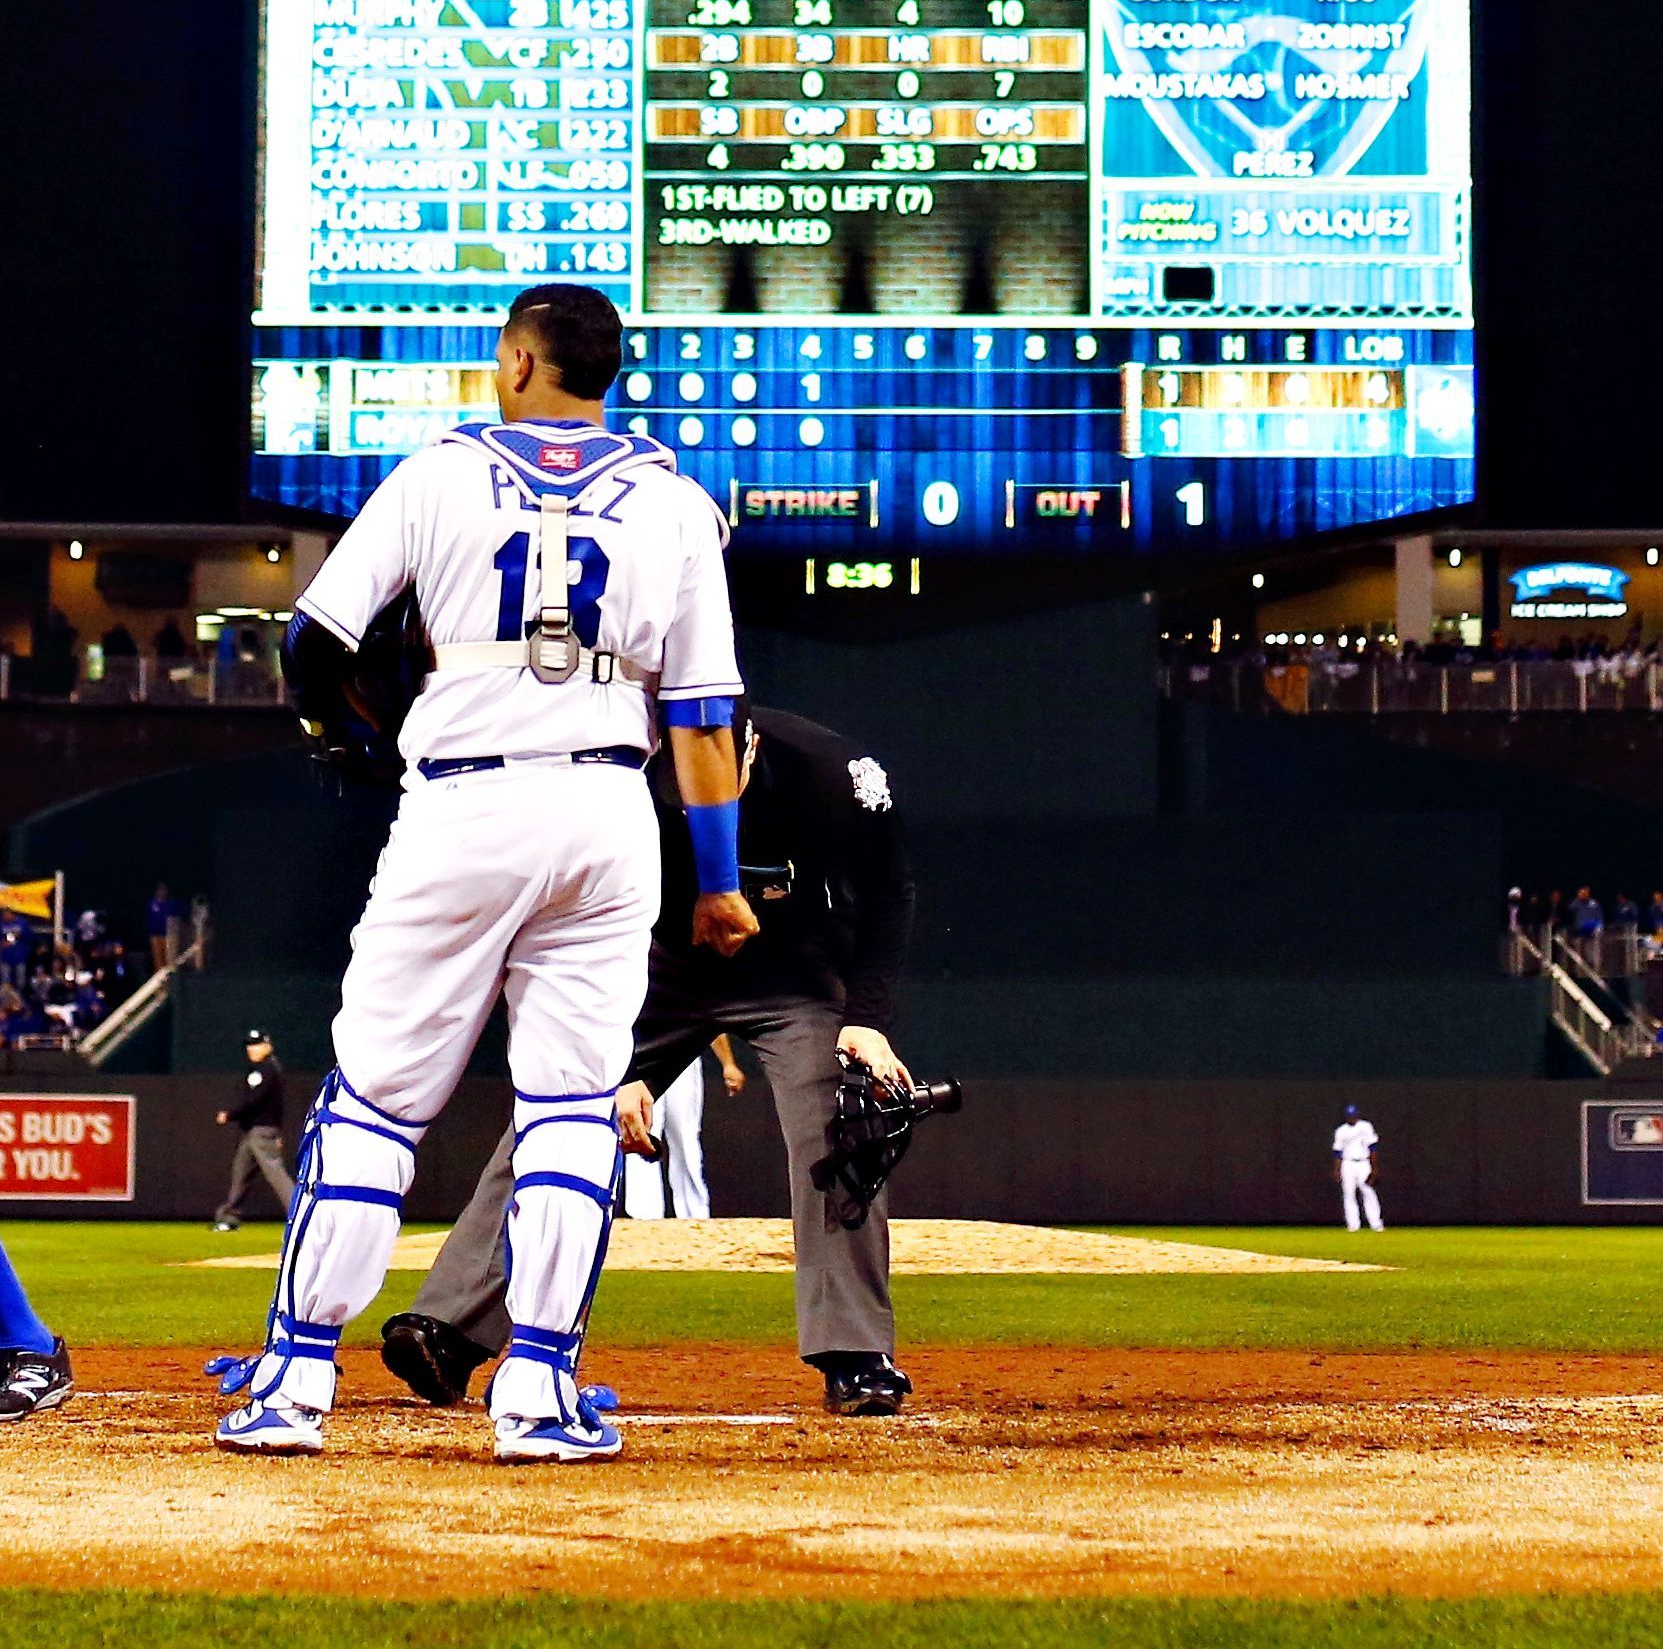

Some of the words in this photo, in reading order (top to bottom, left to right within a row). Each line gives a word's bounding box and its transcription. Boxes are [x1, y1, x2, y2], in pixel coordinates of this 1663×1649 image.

[896, 0, 920, 26] 4
[887, 35, 930, 63] HR
[1123, 23, 1246, 50] ESCOBAR
[1297, 23, 1406, 50] ZOBRIST
[508, 38, 548, 67] CF
[707, 69, 729, 98] 2
[800, 69, 824, 98] 0
[896, 69, 919, 98] 0
[993, 70, 1016, 98] 7
[1103, 73, 1266, 100] MOUSTAKAS
[1294, 73, 1411, 100] HOSMER
[699, 106, 739, 135] SB
[876, 106, 934, 135] SLG
[975, 106, 1034, 135] OPS
[706, 143, 730, 170] 4
[780, 143, 845, 171] .390
[871, 143, 935, 171] .353
[972, 143, 1037, 171] .743
[1232, 150, 1315, 177] PEREZ
[660, 185, 784, 213] 1ST-FLIED
[789, 185, 828, 213] TO
[831, 185, 893, 213] LEFT
[895, 185, 934, 214] (7)
[507, 201, 545, 231] SS
[1231, 208, 1268, 237] 36
[1276, 208, 1411, 240] VOLQUEZ
[658, 218, 832, 246] 3RD-WALKED
[559, 243, 627, 271] .143
[627, 333, 648, 360] 1
[680, 333, 702, 360] 2
[733, 333, 755, 360] 3
[799, 333, 822, 360] 4
[852, 334, 874, 360] 5
[905, 334, 927, 360] 6
[972, 334, 993, 360] 7
[1024, 334, 1047, 360] 8
[1075, 334, 1098, 360] 9
[1157, 335, 1181, 361] R
[1221, 335, 1246, 361] H
[1285, 335, 1306, 361] E
[1344, 335, 1405, 361] LOB
[625, 371, 653, 402] 0
[678, 371, 706, 402] 0
[731, 371, 758, 402] 0
[800, 372, 822, 402] 1
[1157, 373, 1180, 403] 1
[678, 415, 706, 447] 0
[730, 415, 758, 447] 0
[798, 415, 825, 447] 0
[1159, 418, 1180, 448] 1
[745, 491, 860, 517] STRIKE
[921, 482, 960, 525] 0
[1035, 491, 1100, 517] OUT
[1175, 482, 1206, 526] 1
[826, 562, 893, 588] 8:36
[21, 1111, 113, 1145] BUD'S
[13, 1151, 81, 1181] YOU.
